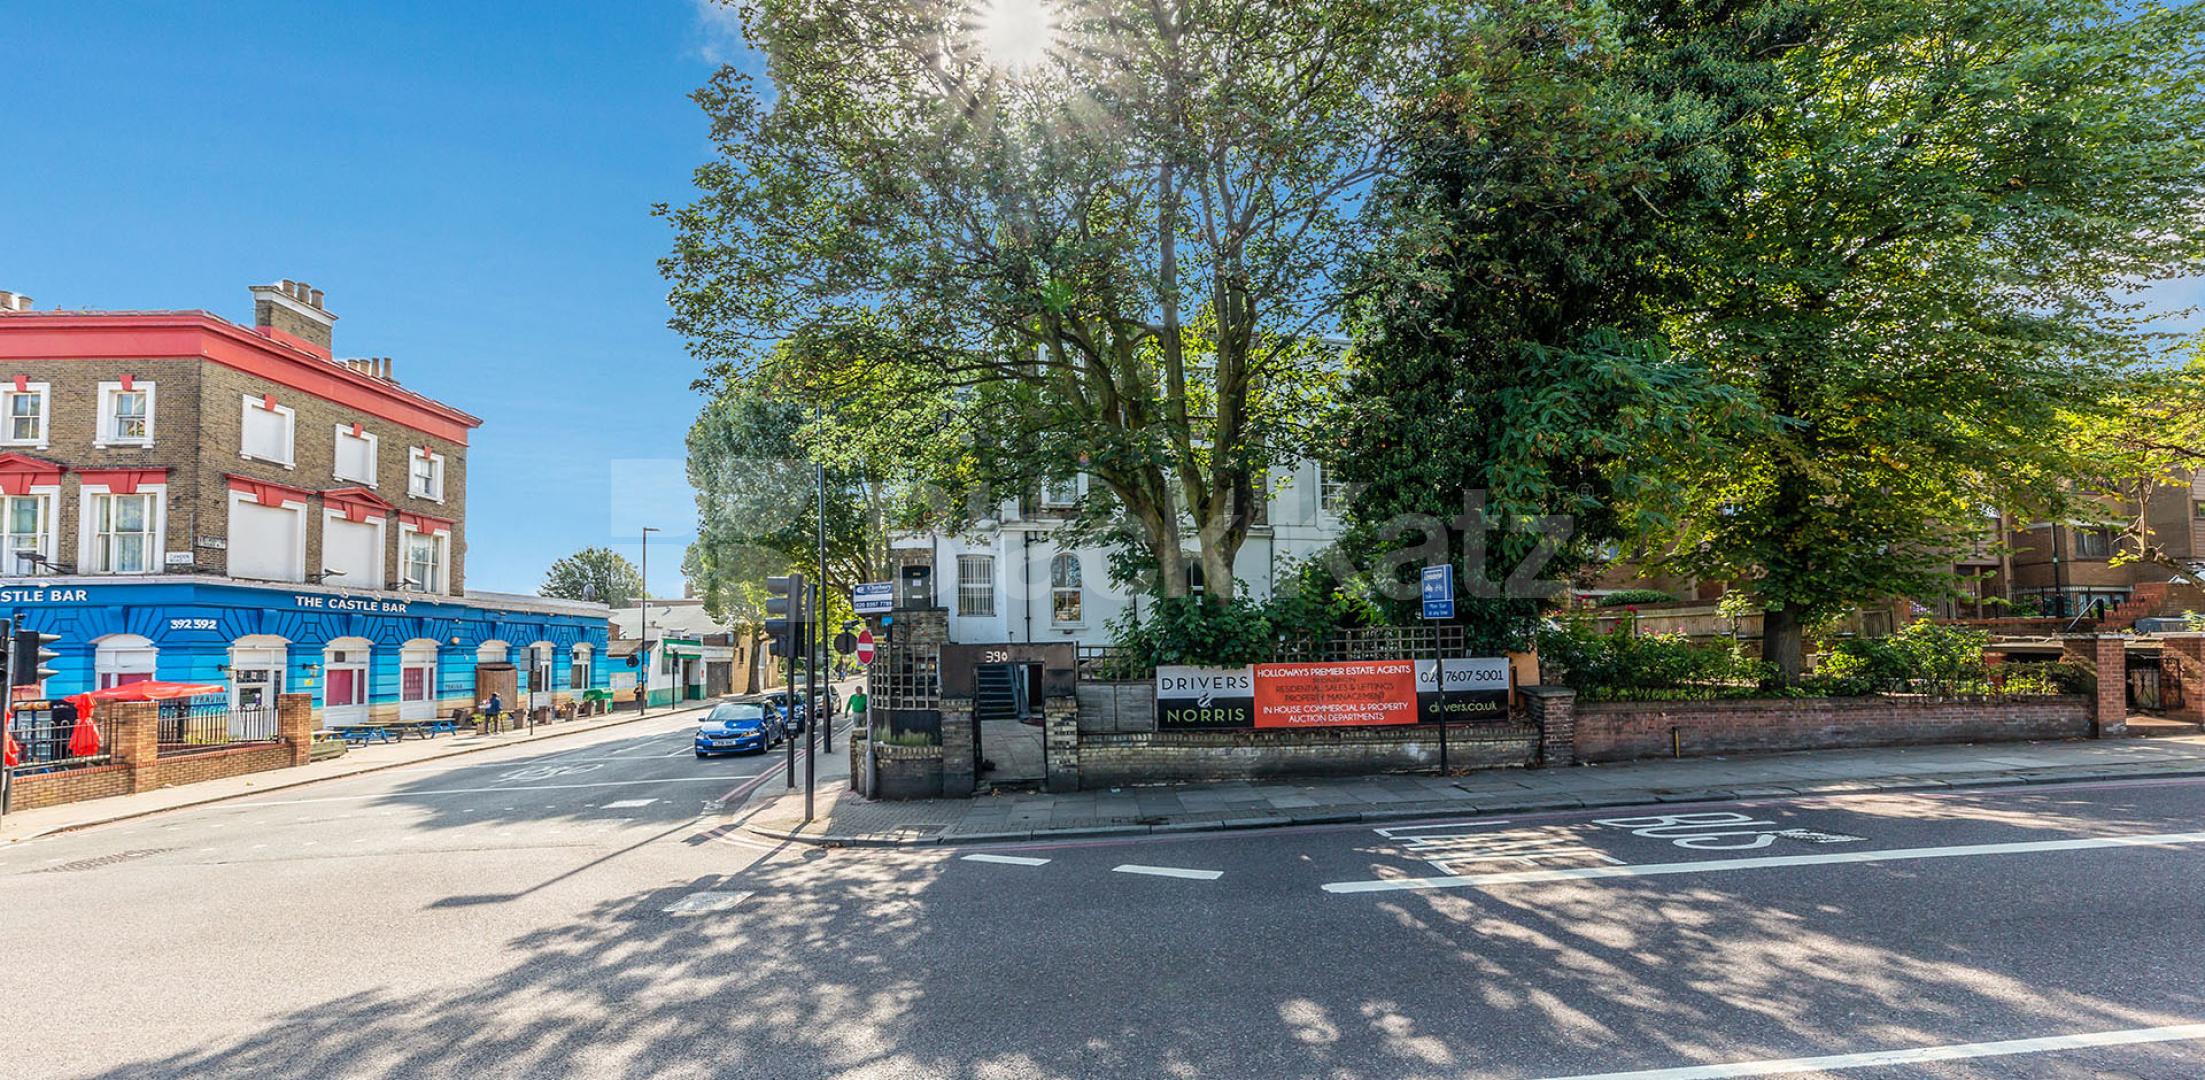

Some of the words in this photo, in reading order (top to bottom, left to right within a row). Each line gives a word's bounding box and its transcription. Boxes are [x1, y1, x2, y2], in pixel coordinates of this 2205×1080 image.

[50, 589, 88, 602] BAR
[295, 595, 323, 608] THE
[328, 598, 378, 611] CASTLE
[382, 602, 407, 613] BAR
[170, 619, 192, 629] 392
[986, 651, 1008, 662] 390
[1257, 669, 1309, 678] HOLLOWAYS
[1311, 667, 1345, 676] PREMIER
[1346, 666, 1375, 675] ESTATE
[1377, 665, 1411, 674] AGENTS
[1445, 670, 1473, 682] 7607
[1475, 669, 1504, 681] 5001
[1161, 676, 1249, 690] DRIVERS
[1197, 691, 1213, 708] &
[1284, 694, 1324, 702] PROPERTY
[1263, 706, 1272, 714] IN
[1274, 705, 1301, 713] HOUSE
[1303, 703, 1358, 713] COMMERCIAL
[1360, 703, 1366, 711] &
[1367, 702, 1408, 711] PROPERTY
[1429, 700, 1497, 714] dvers.co.uk
[1167, 708, 1245, 722] NORRIS
[1289, 715, 1326, 723] AUCTION
[1328, 713, 1384, 722] DEPARTMENTS
[1591, 811, 1777, 851] BUS
